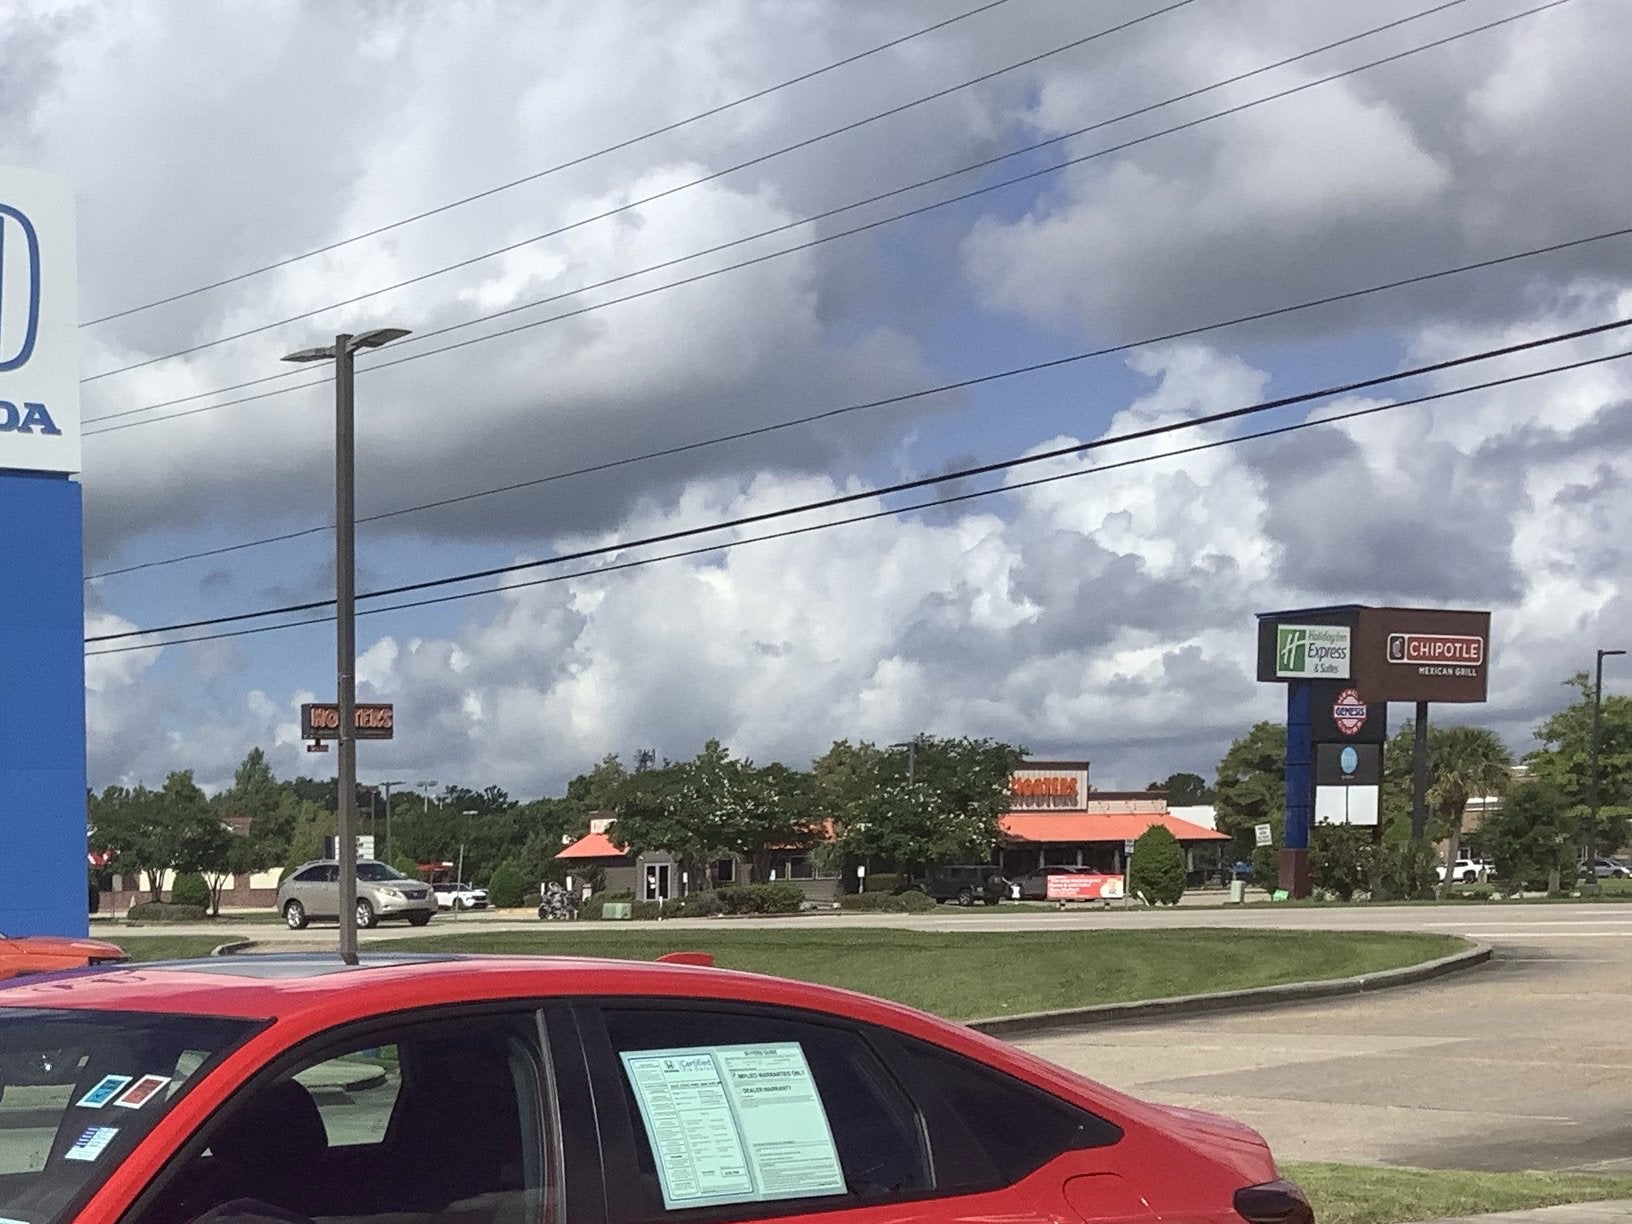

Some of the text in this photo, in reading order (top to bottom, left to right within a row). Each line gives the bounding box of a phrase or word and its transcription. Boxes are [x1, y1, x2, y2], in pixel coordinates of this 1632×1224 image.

[1308, 642, 1347, 662] Express
[1409, 641, 1479, 658] CHIPOTLE
[1418, 666, 1477, 677] MEXICAN GRILL
[1335, 706, 1366, 717] GENESIS
